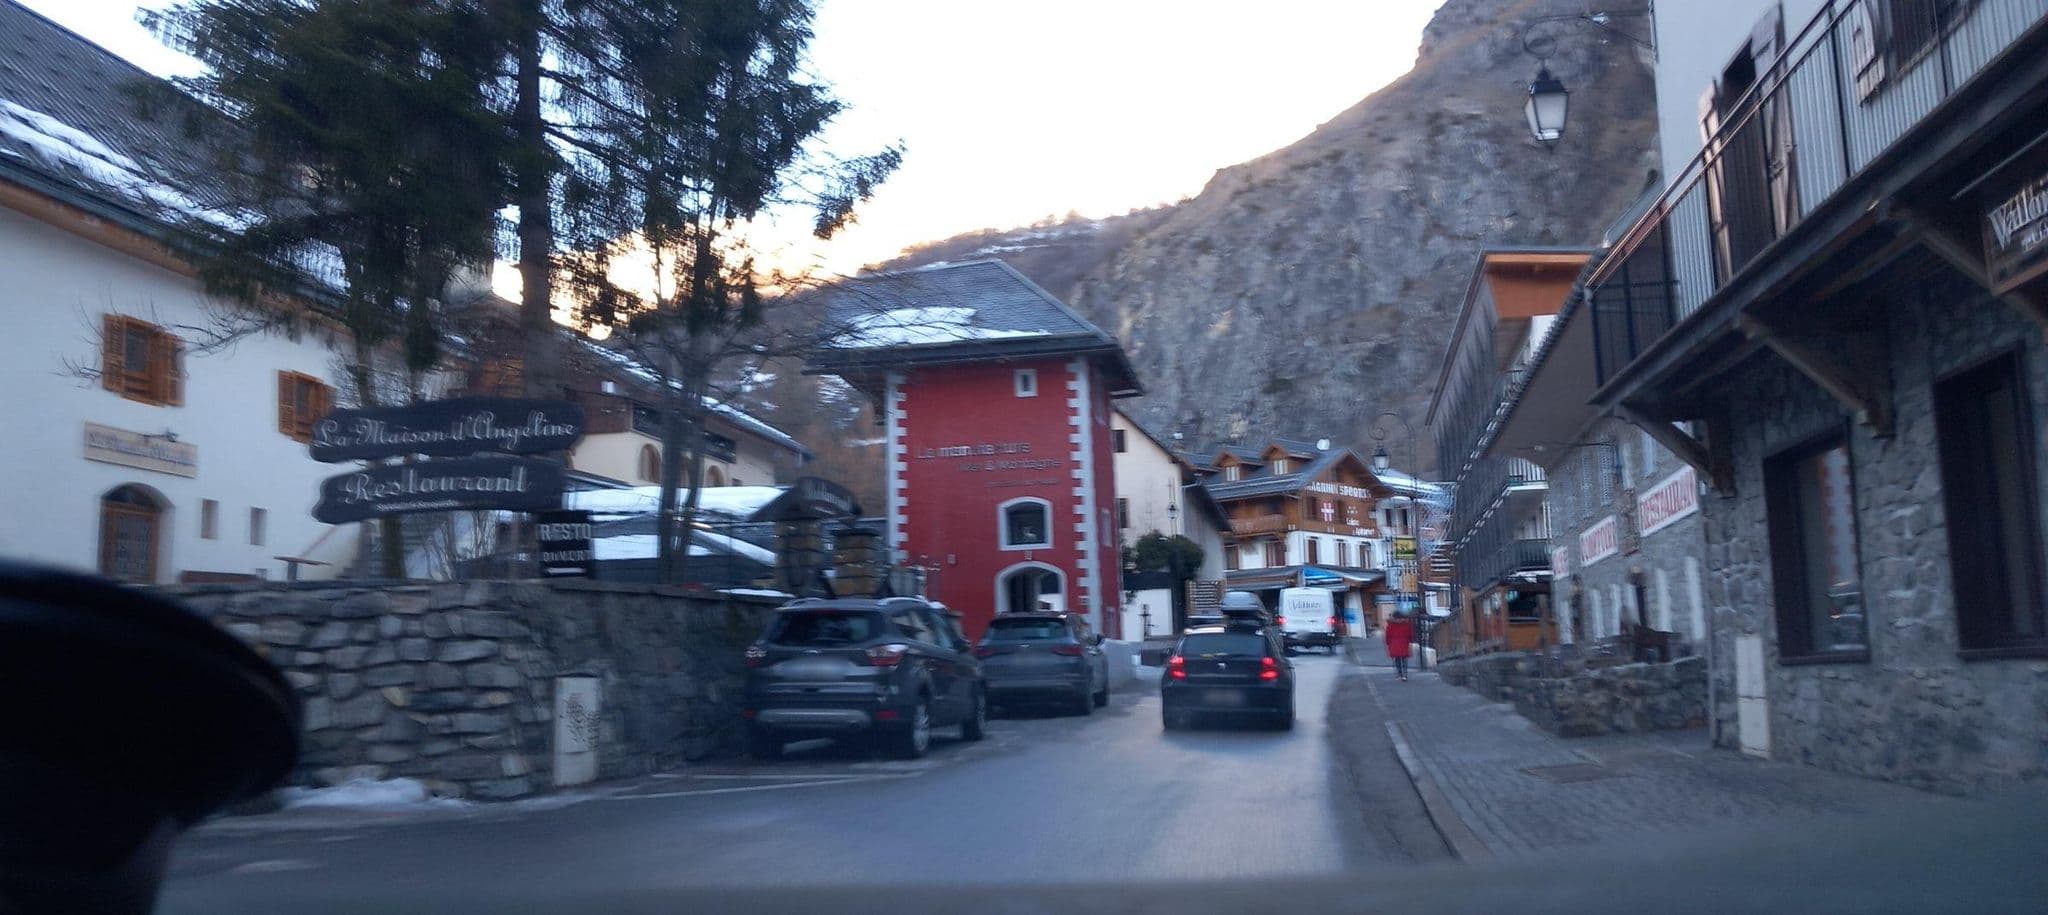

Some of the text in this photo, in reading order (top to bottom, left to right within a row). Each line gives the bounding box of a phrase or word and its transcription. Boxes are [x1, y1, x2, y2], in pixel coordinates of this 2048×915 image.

[316, 420, 347, 447] La
[355, 417, 447, 444] Maison
[345, 465, 531, 504] Restaurant
[540, 523, 591, 541] RESTO
